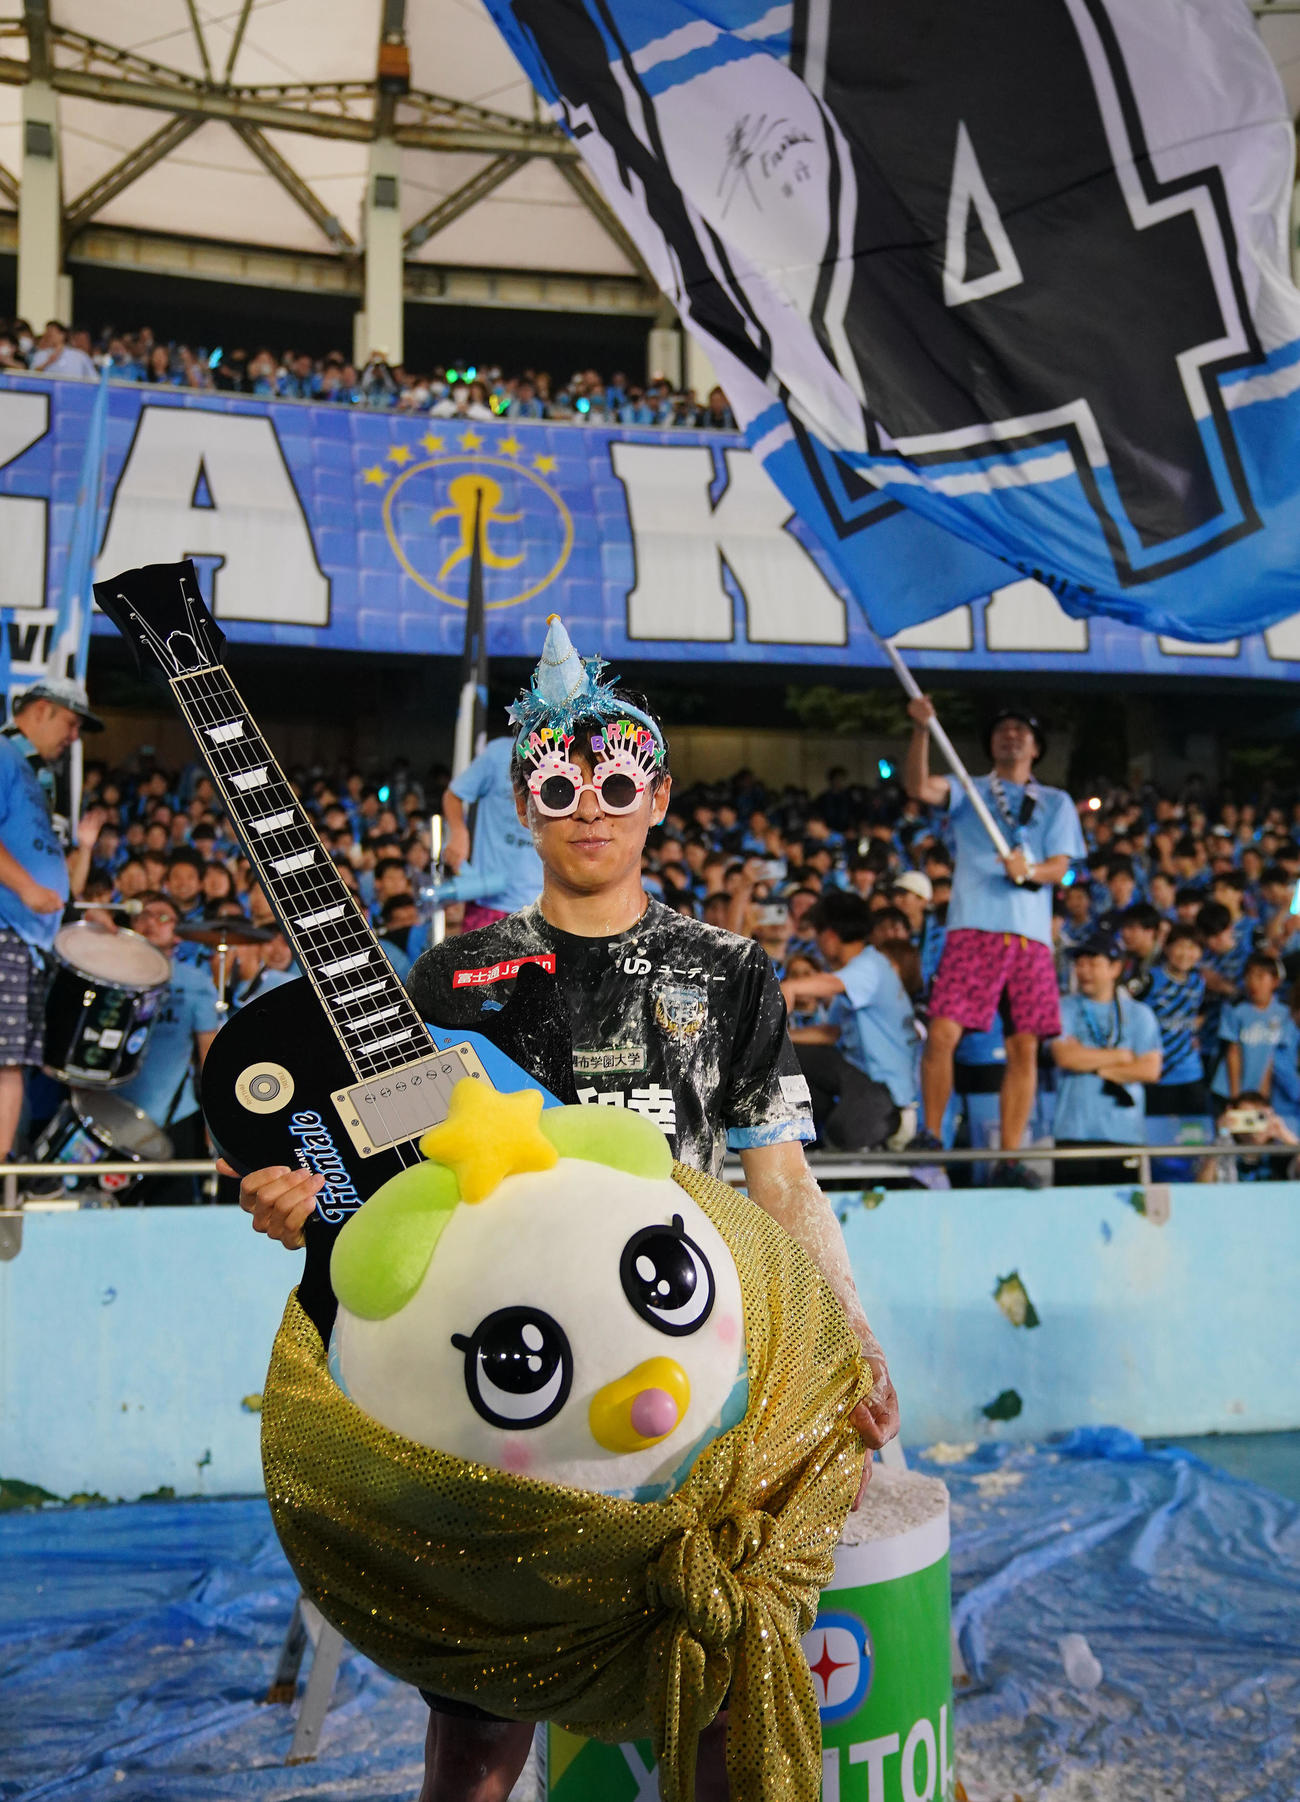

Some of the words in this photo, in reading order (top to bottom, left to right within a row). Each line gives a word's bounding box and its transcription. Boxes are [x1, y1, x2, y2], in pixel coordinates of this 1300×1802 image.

[517, 727, 575, 760] HAPPY
[590, 719, 666, 766] BIRTHDAY
[288, 1109, 365, 1224] Frontale
